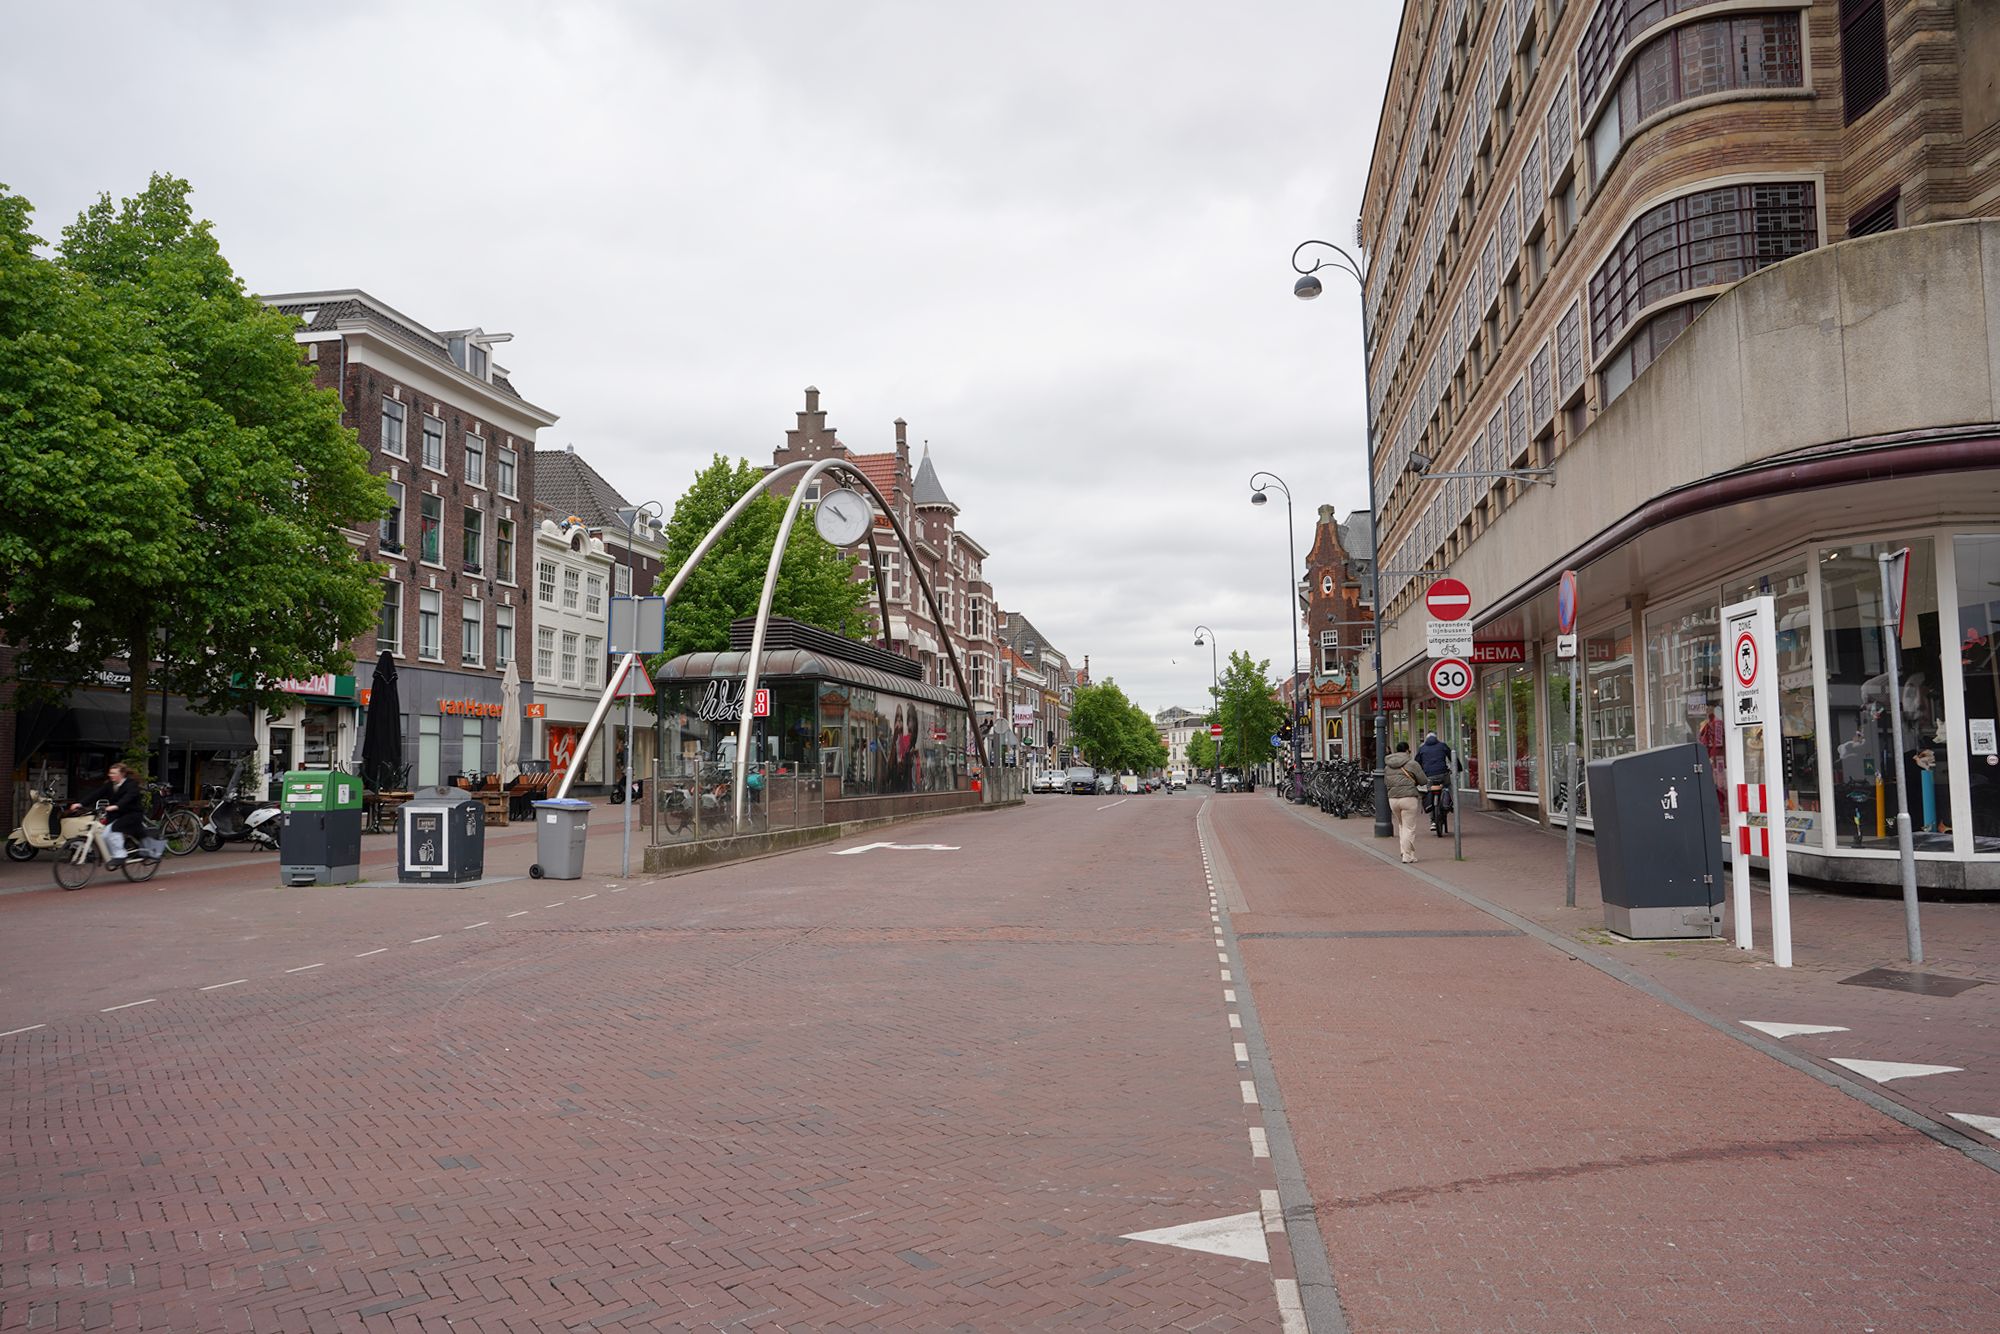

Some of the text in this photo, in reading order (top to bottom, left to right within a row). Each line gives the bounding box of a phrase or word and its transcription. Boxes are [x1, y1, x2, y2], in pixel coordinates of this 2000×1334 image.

[1738, 620, 1751, 631] ZONE
[1474, 646, 1520, 660] HEMA
[1437, 671, 1465, 687] 30
[439, 698, 504, 717] vanHaren
